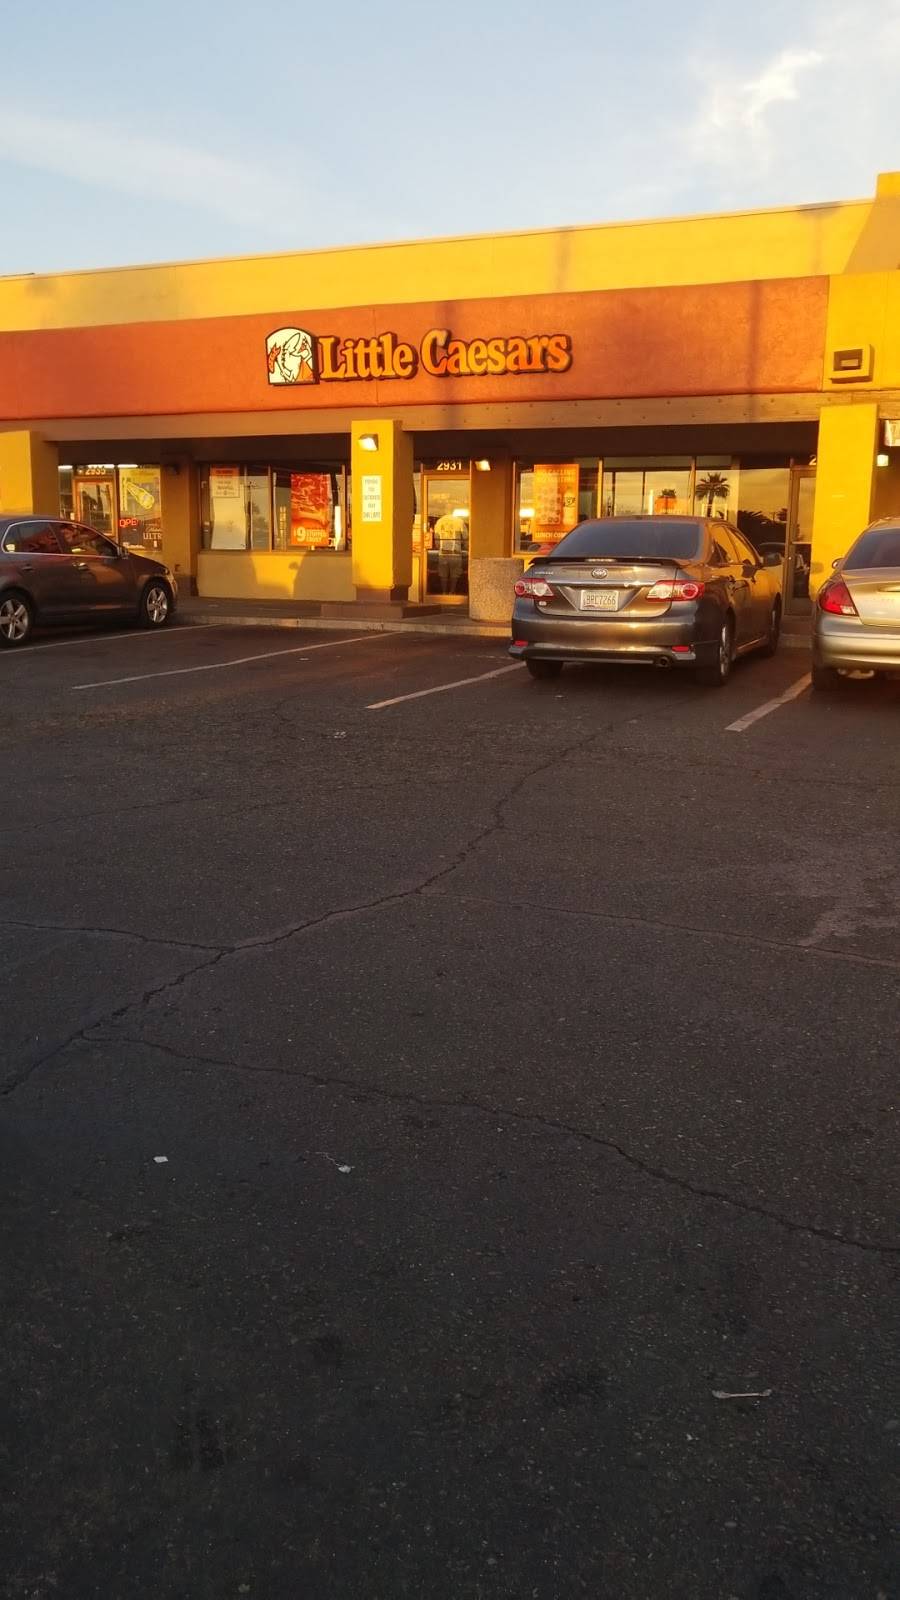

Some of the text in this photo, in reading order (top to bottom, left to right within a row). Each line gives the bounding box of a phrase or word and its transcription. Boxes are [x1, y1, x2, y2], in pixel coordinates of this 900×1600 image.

[318, 328, 571, 380] Little Caesars
[436, 461, 463, 471] 2931
